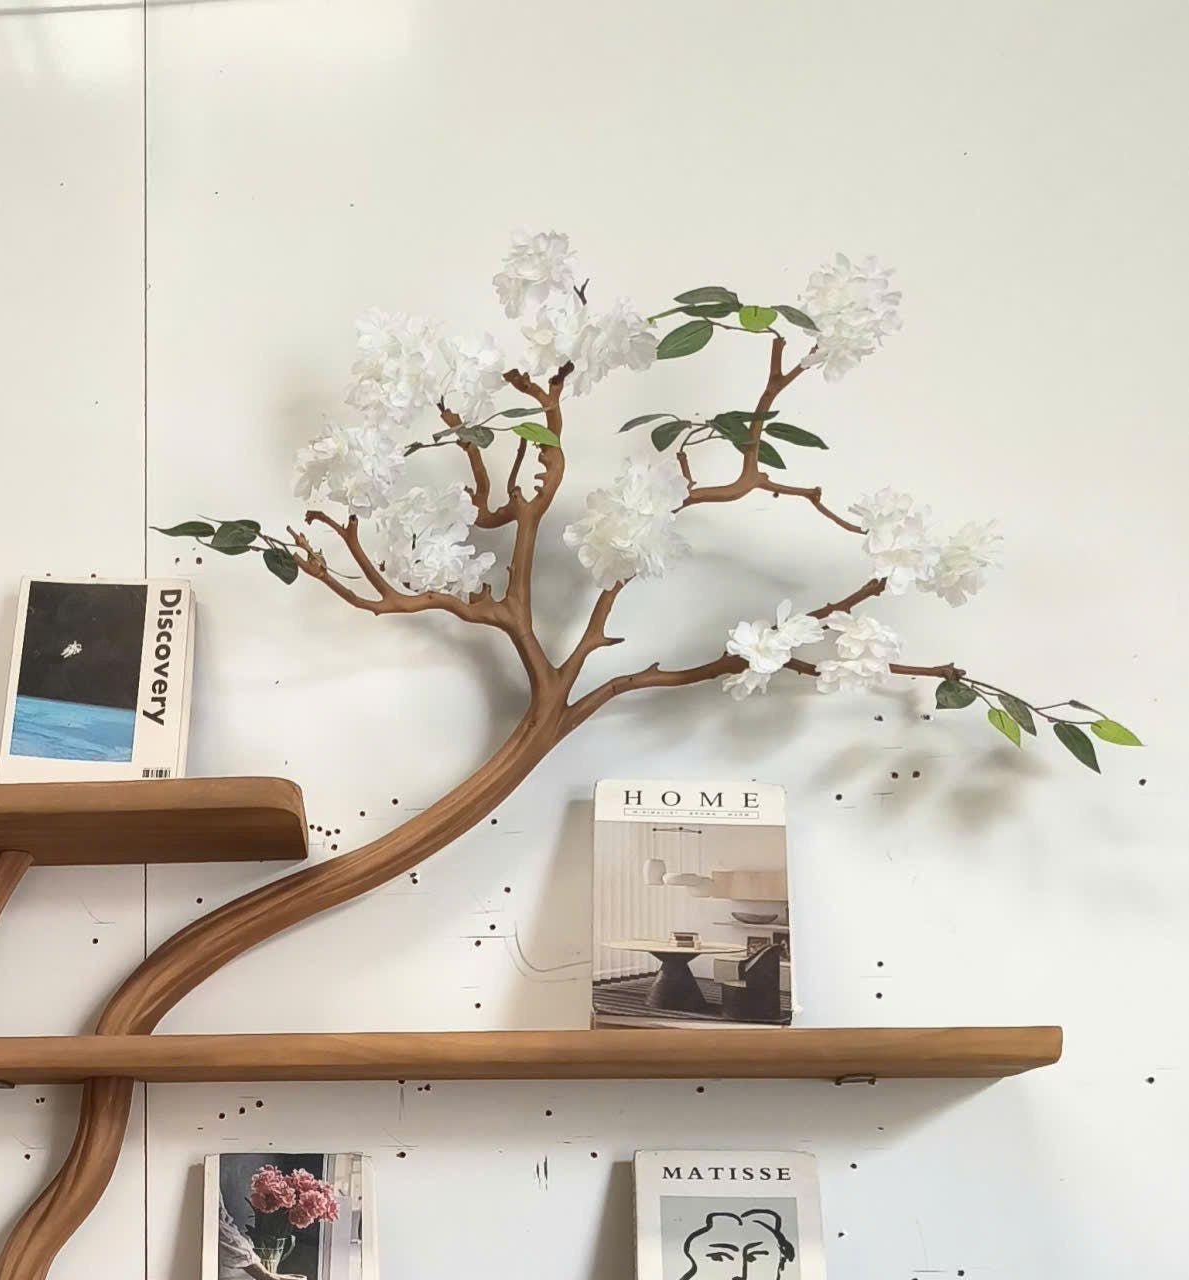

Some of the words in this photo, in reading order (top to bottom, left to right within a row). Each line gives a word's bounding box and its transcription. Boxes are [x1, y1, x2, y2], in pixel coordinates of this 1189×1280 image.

[142, 589, 182, 726] Discovery
[623, 790, 760, 808] HOME
[662, 1166, 792, 1181] MATISSE
